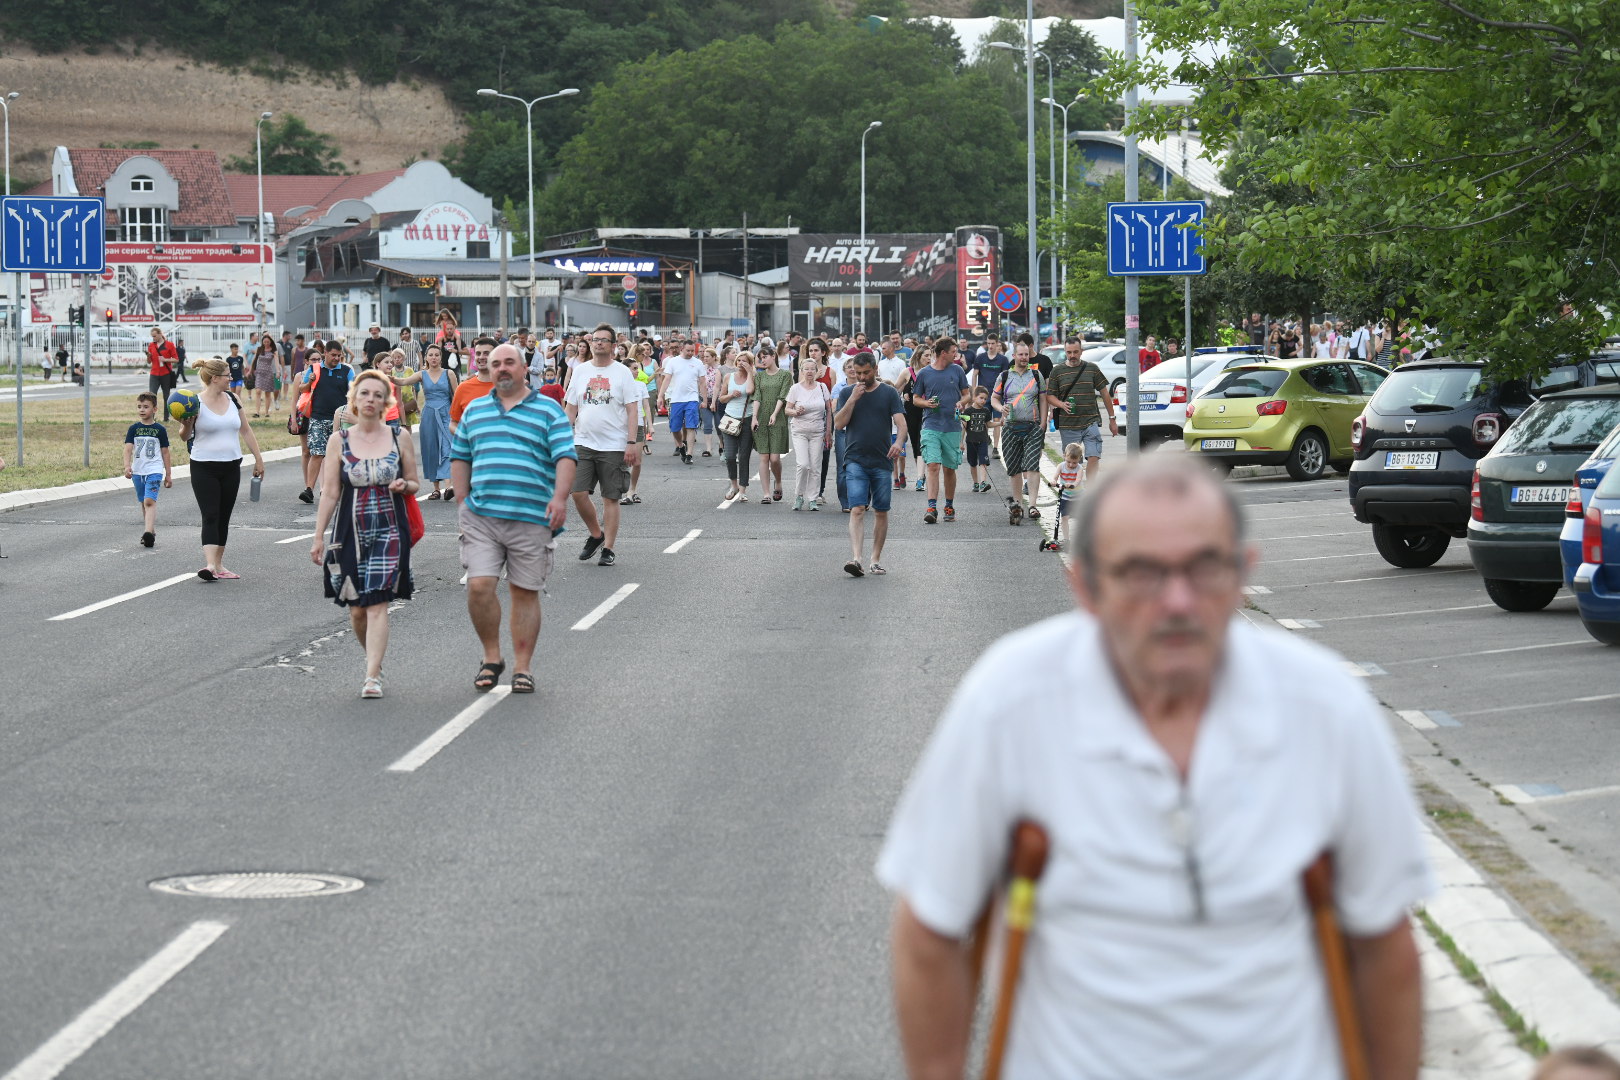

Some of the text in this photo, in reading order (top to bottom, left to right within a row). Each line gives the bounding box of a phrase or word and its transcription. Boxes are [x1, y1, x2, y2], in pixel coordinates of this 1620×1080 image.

[404, 224, 489, 242] МАЦУРА
[121, 248, 150, 256] сервис
[205, 247, 255, 256] традијом
[803, 246, 908, 264] HARLI
[580, 262, 655, 272] MICHELIN
[135, 439, 157, 459] 78
[1518, 489, 1531, 502] BG
